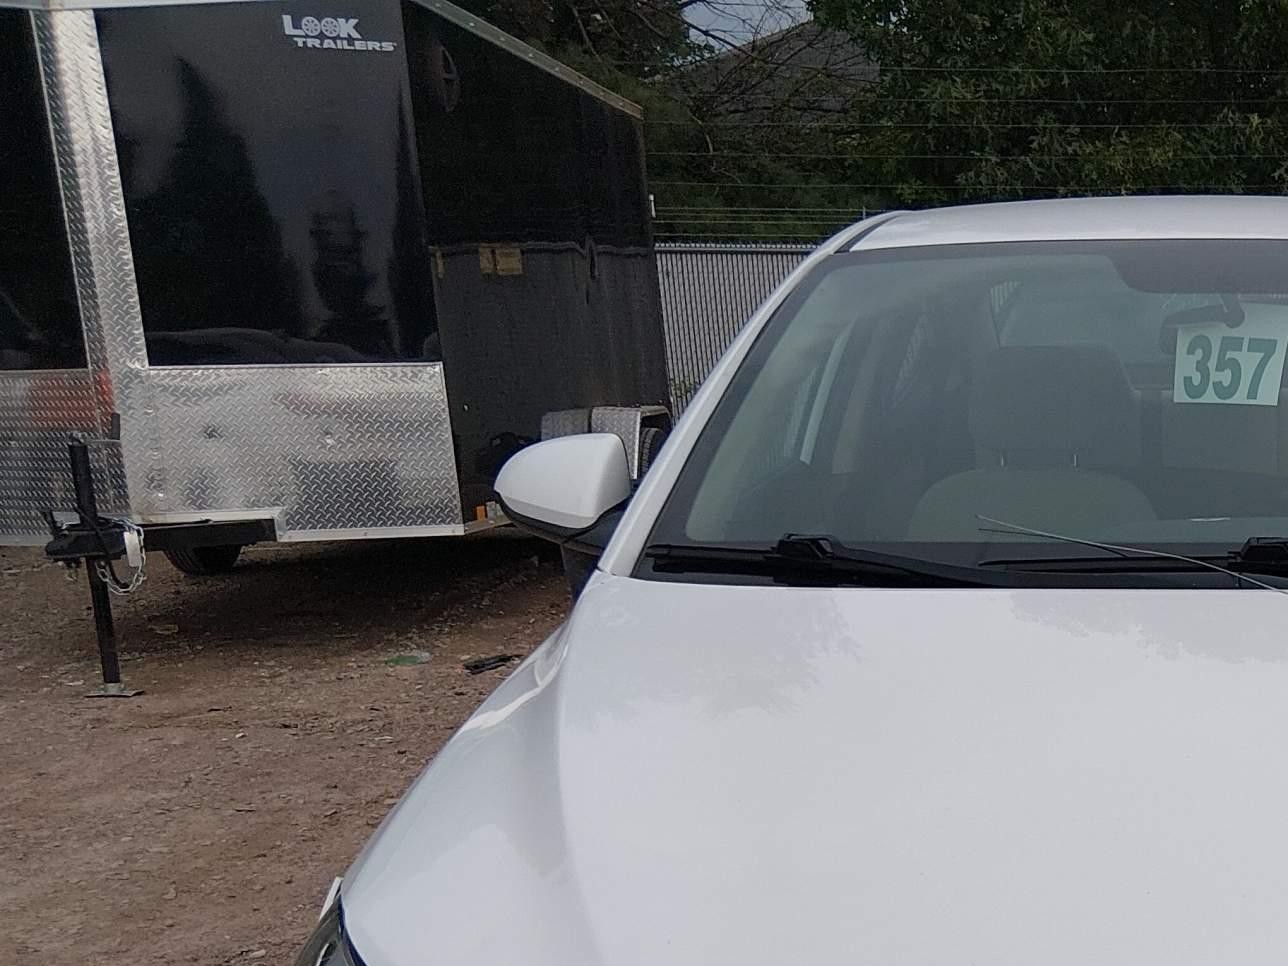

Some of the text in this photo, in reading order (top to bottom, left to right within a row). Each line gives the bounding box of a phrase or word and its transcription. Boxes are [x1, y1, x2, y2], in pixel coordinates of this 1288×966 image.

[281, 14, 362, 39] LOOK
[293, 37, 396, 52] TRAILERS
[1183, 334, 1278, 401] 357
